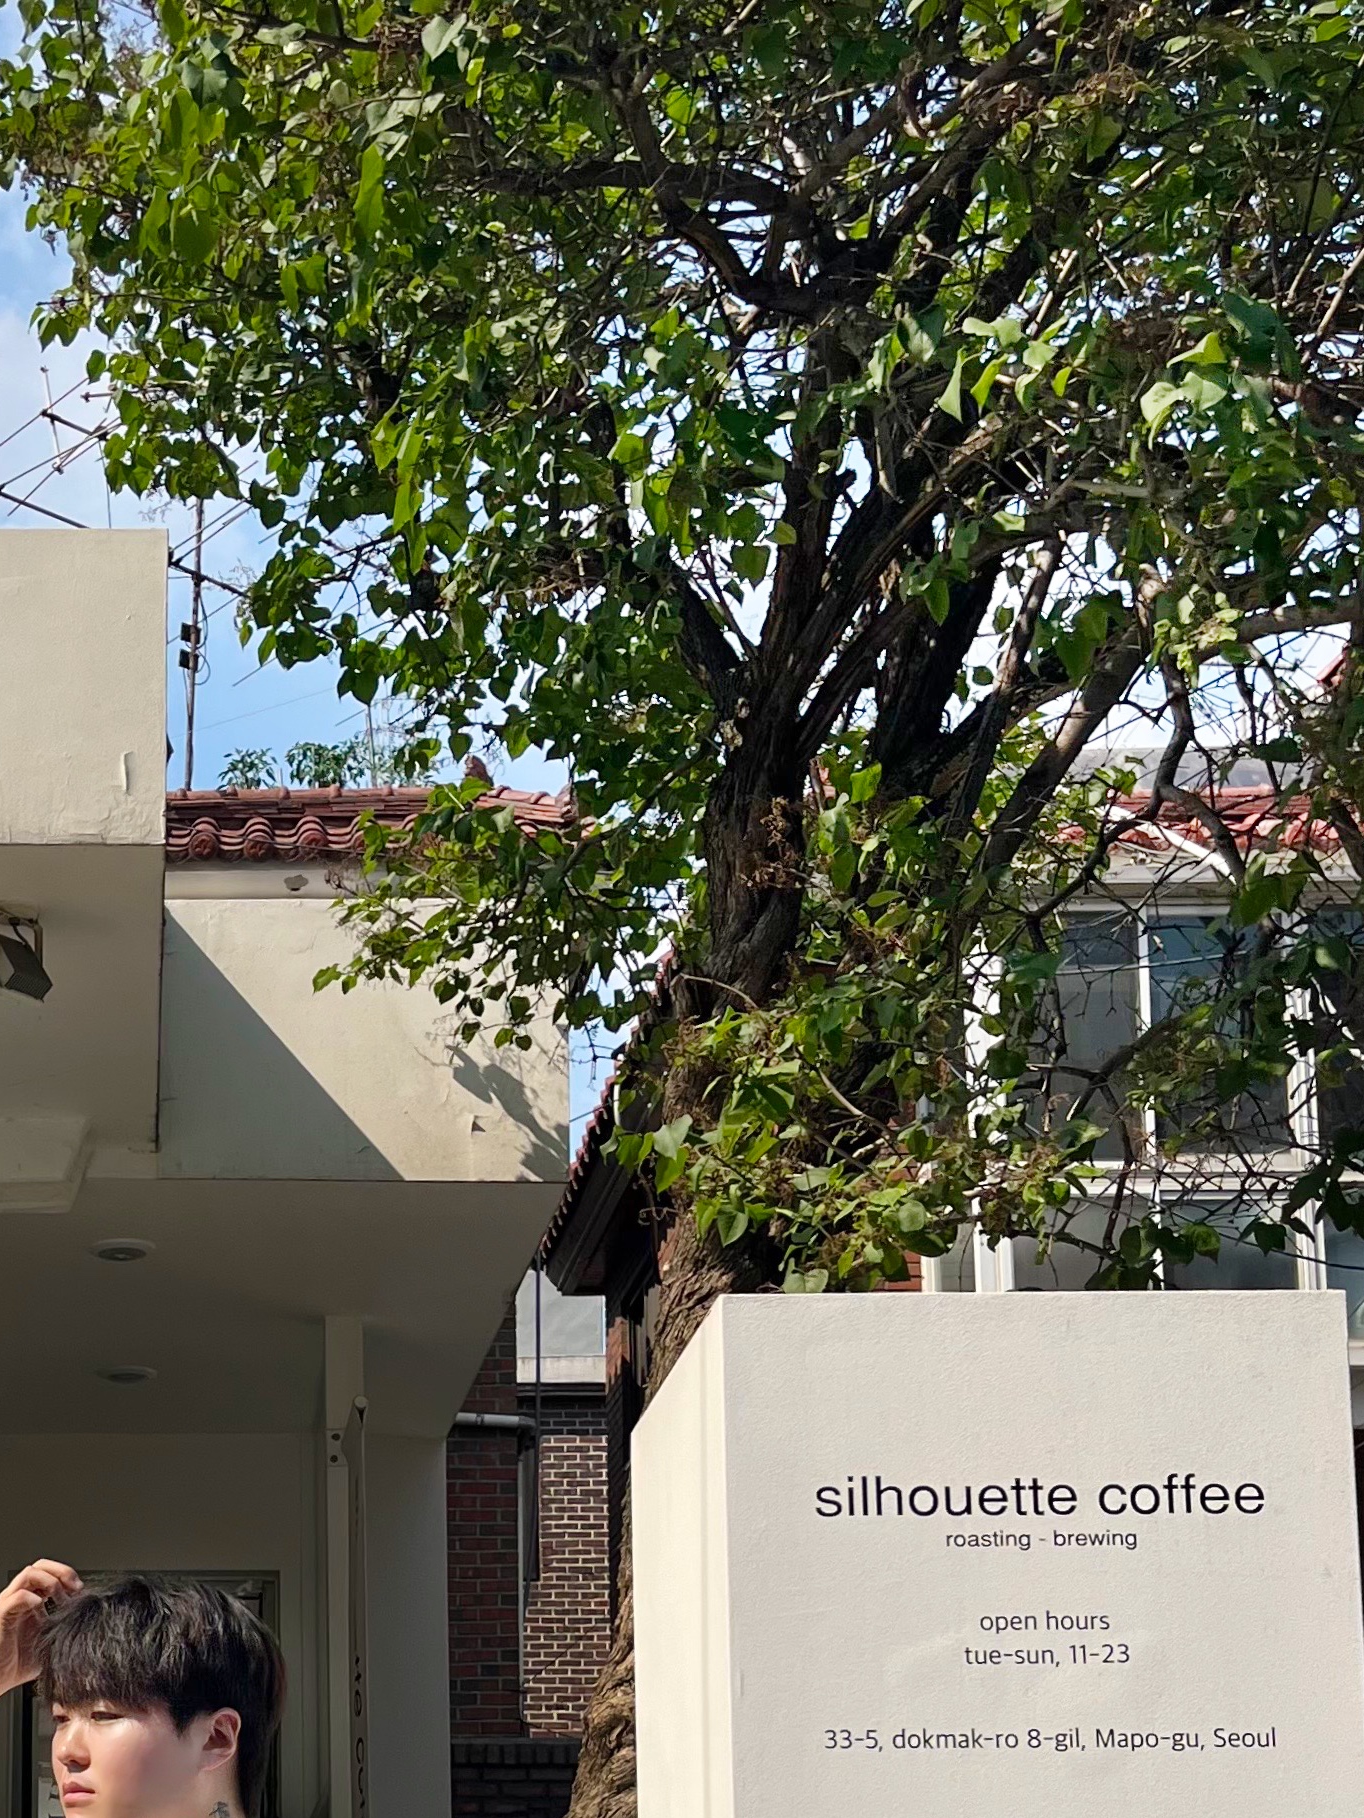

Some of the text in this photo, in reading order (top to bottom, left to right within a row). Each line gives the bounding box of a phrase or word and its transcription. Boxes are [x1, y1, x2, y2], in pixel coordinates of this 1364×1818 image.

[816, 1473, 1264, 1517] silhouette coffee
[946, 1529, 1031, 1551] roasting
[1053, 1528, 1138, 1551] brewing
[980, 1610, 1111, 1634] open hours
[964, 1643, 1130, 1668] tue-sun, 11-23
[824, 1726, 1277, 1753] 33-5, dokmak-ro 8-gil, Mapo-gu, Seoul
